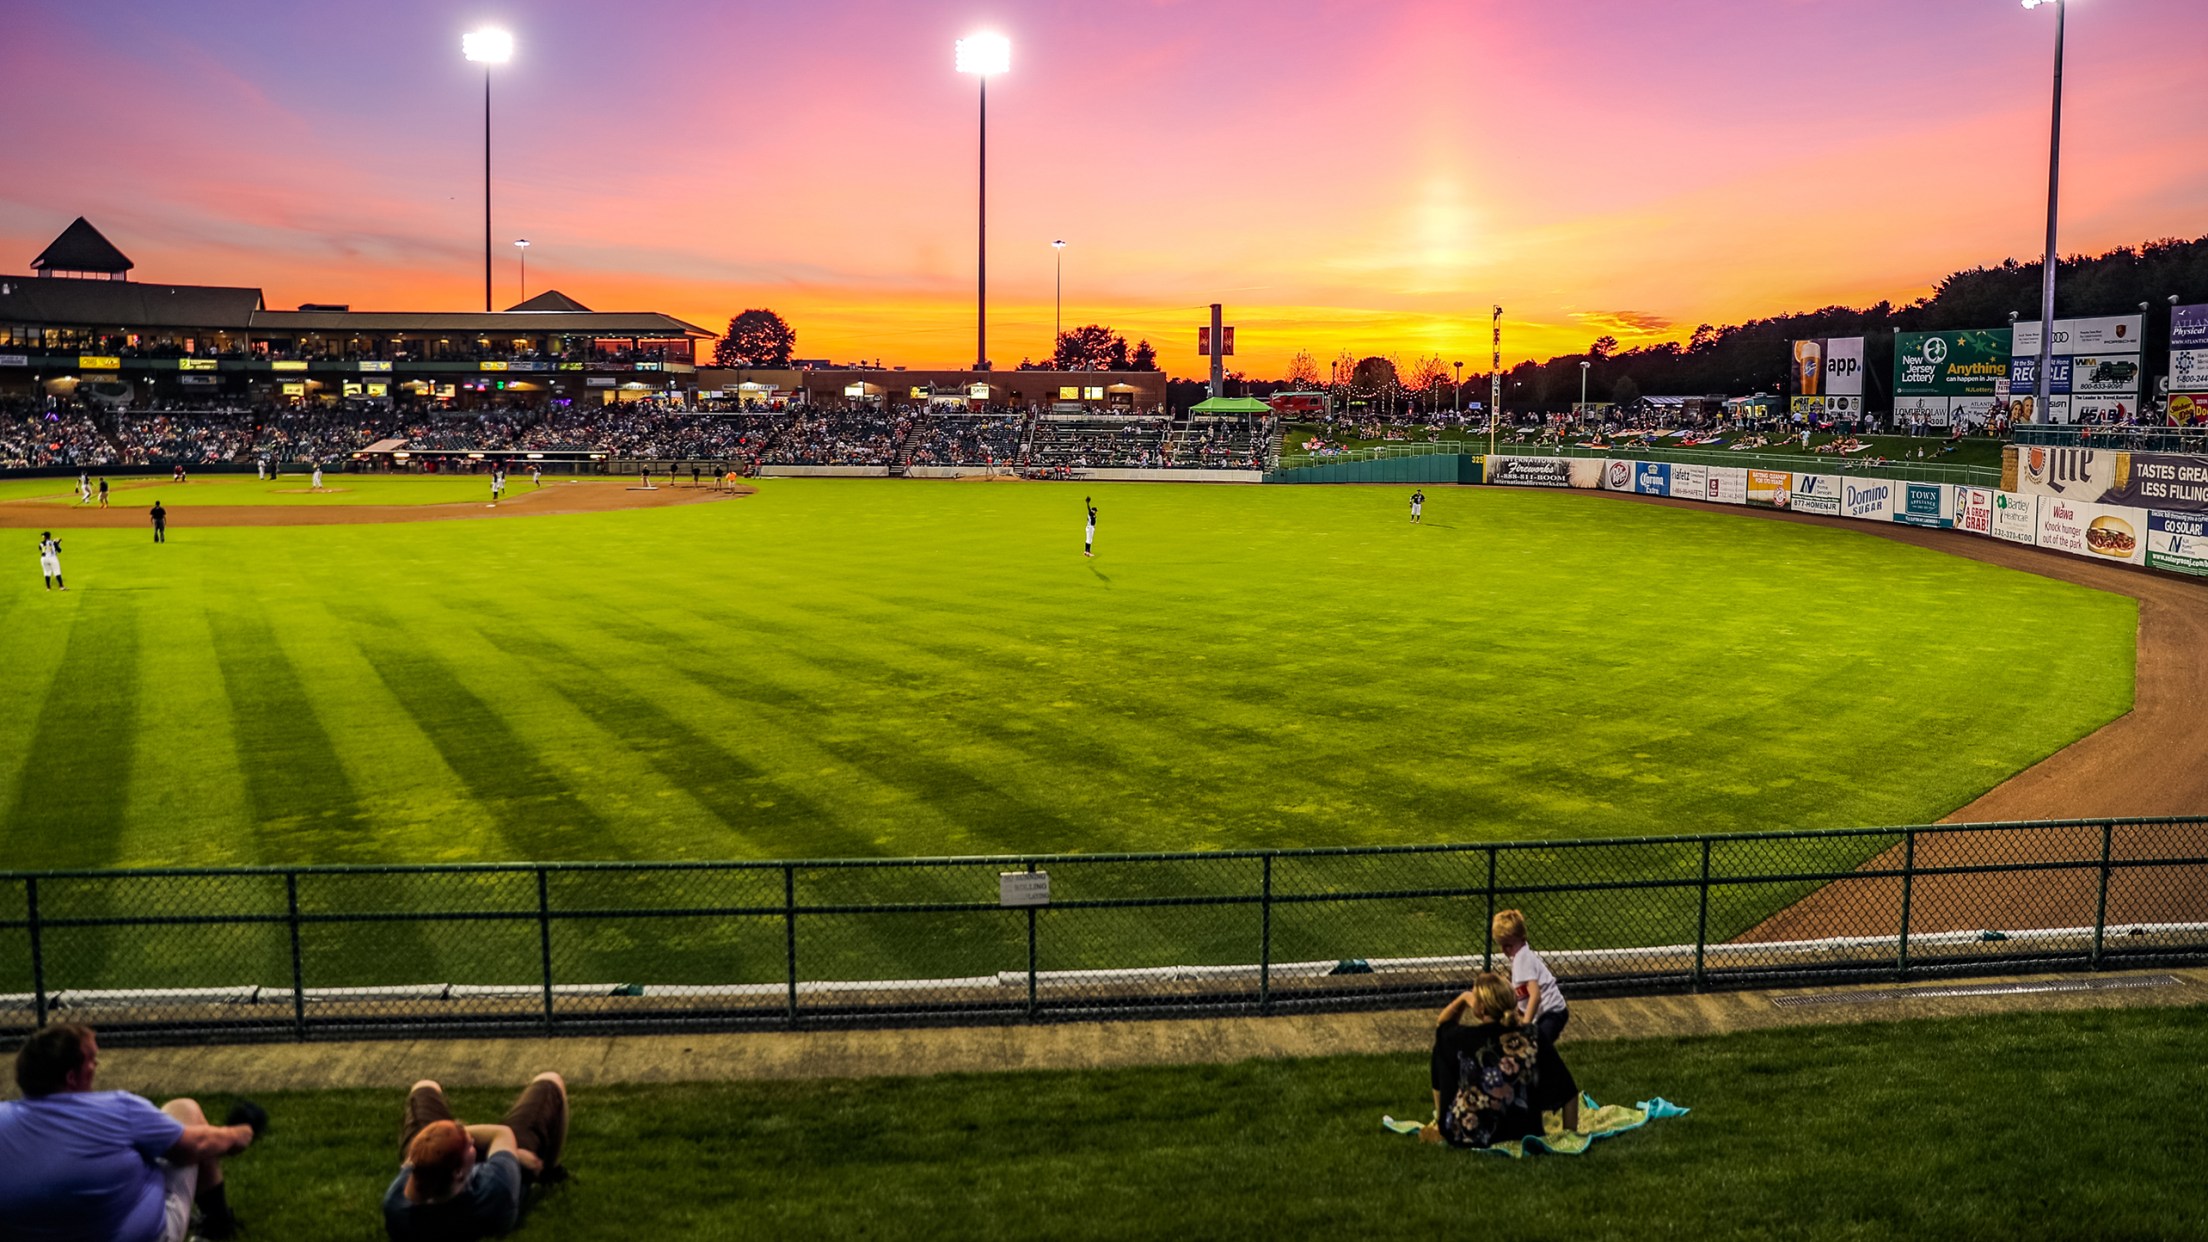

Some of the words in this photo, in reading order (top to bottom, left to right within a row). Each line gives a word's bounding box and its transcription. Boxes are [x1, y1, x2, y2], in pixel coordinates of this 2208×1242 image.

[2176, 318, 2208, 327] ATLAN
[2173, 326, 2206, 337] Physical
[1828, 357, 1861, 376] app.
[1902, 355, 1924, 365] New
[2075, 358, 2097, 366] WM
[1906, 364, 1936, 375] Jersey
[1947, 362, 2006, 376] Anything
[2012, 366, 2070, 381] RECLE
[1901, 372, 1935, 384] Lottery
[2176, 375, 2208, 383] 1-800-244
[1472, 456, 1484, 464] 325
[1508, 462, 1554, 474] Fireworks
[2136, 463, 2176, 480] TASTES
[2177, 465, 2208, 483] GREA
[1640, 472, 1664, 486] Corona
[1847, 485, 1888, 507] Domino
[1910, 490, 1936, 500] TOWN
[2141, 481, 2167, 498] LESS
[1852, 501, 1883, 516] SUGAR
[1966, 506, 1971, 515] A
[1971, 507, 1990, 519] GREAT
[2008, 497, 2030, 514] Bartley
[2053, 505, 2073, 521] Wawa
[1965, 516, 1989, 532] GRAB!
[2045, 520, 2061, 533] Knock
[2062, 523, 2082, 538] hunger
[2164, 520, 2176, 533] GO
[2176, 521, 2203, 536] SOLAR!
[2043, 535, 2052, 544] out
[2060, 536, 2069, 547] the
[2070, 539, 2082, 550] park
